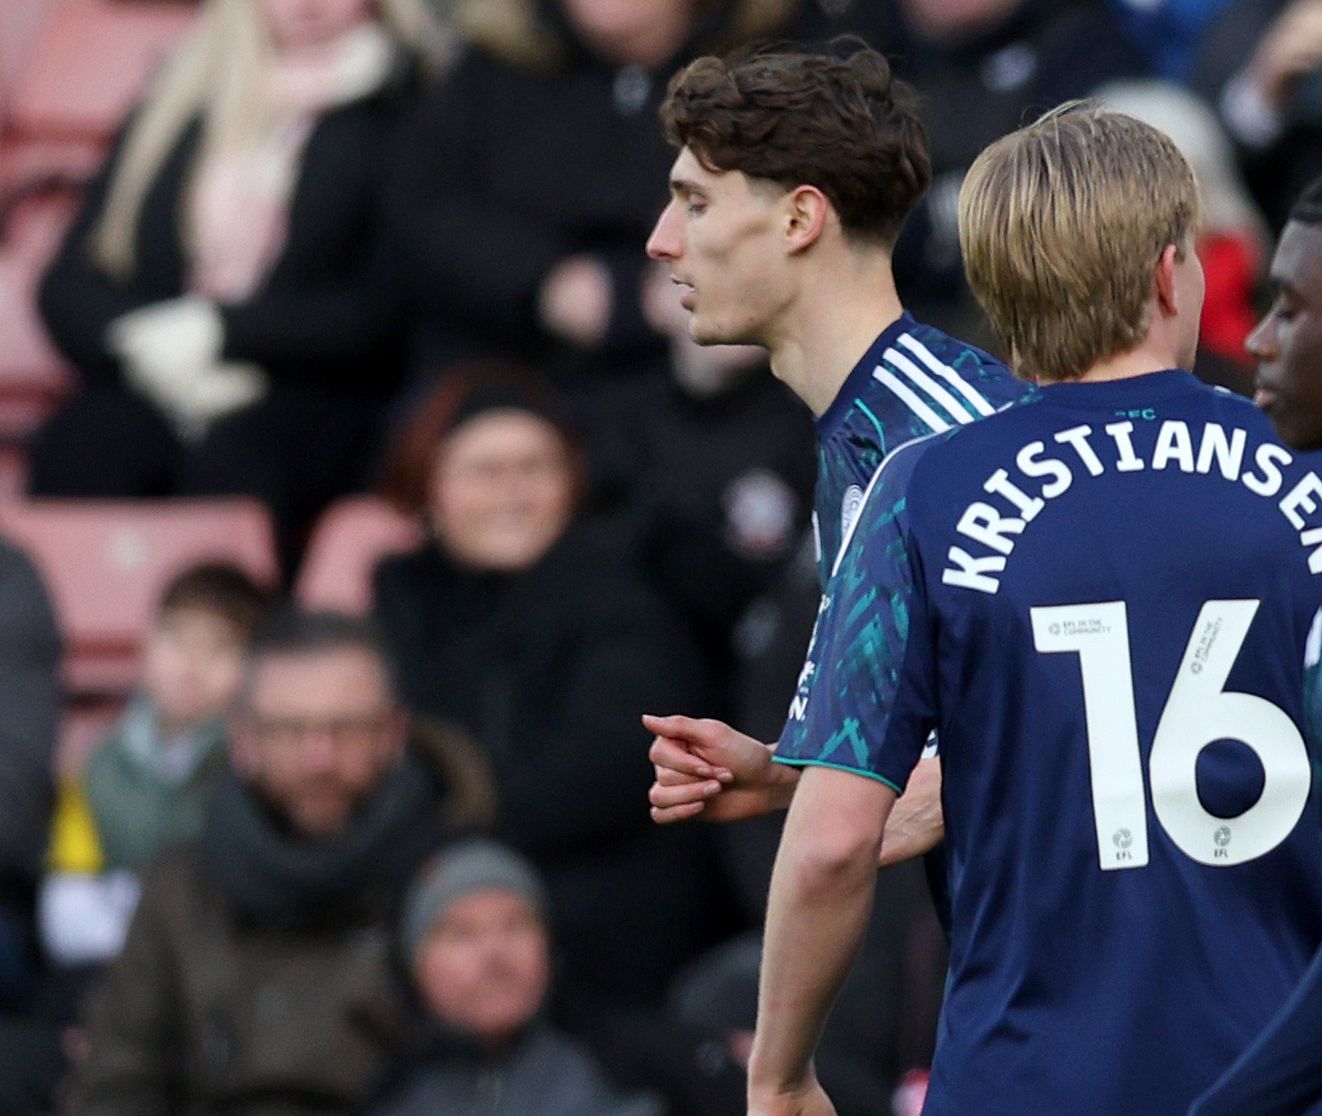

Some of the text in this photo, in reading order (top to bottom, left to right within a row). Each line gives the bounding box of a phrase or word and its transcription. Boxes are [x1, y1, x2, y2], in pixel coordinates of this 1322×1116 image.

[1029, 599, 1312, 871] 16
[1115, 851, 1132, 861] EFL
[1213, 849, 1229, 859] EFL
